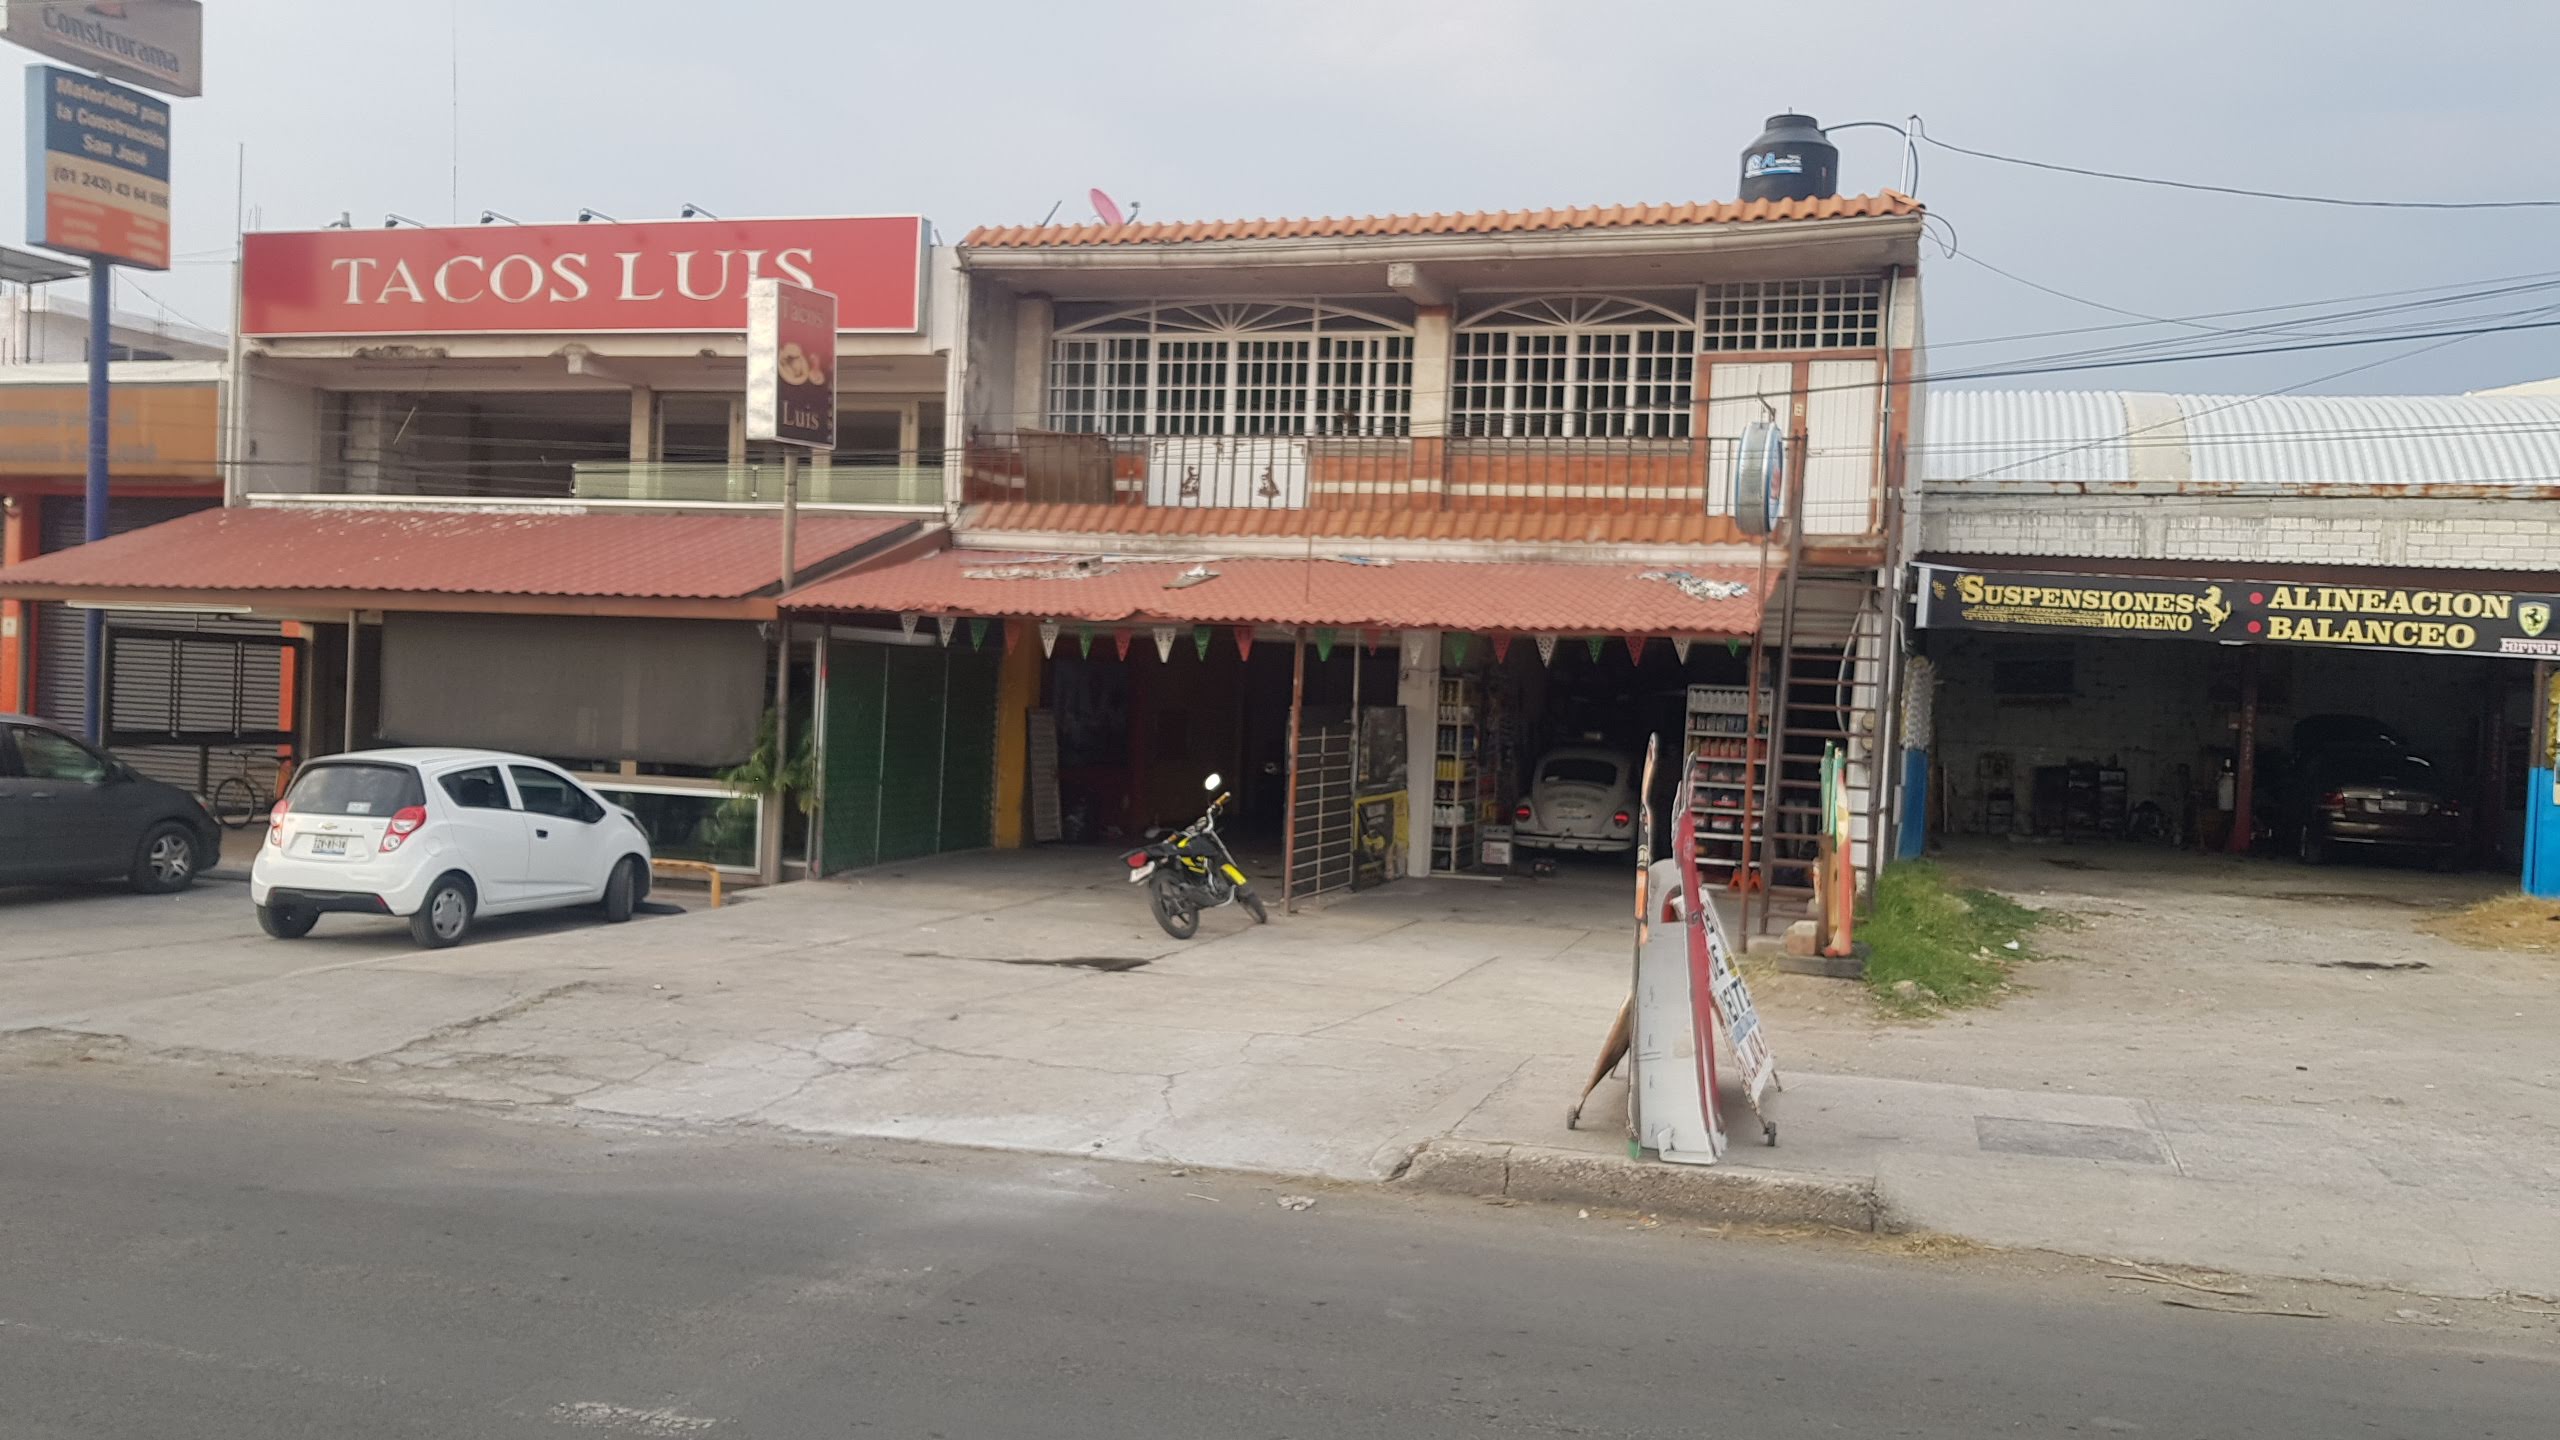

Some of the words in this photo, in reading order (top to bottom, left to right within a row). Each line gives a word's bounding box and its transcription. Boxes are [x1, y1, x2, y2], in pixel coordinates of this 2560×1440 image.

[44, 7, 179, 73] Construrama
[332, 252, 589, 304] TACOS
[614, 248, 813, 301] LUIS
[781, 296, 825, 329] Tacos
[782, 400, 820, 430] Luis
[1961, 574, 2196, 614] SUSPENSIONES
[2266, 586, 2513, 619] ALINEACION
[2100, 611, 2193, 632] MORENO
[2266, 615, 2477, 649] BALANCEO
